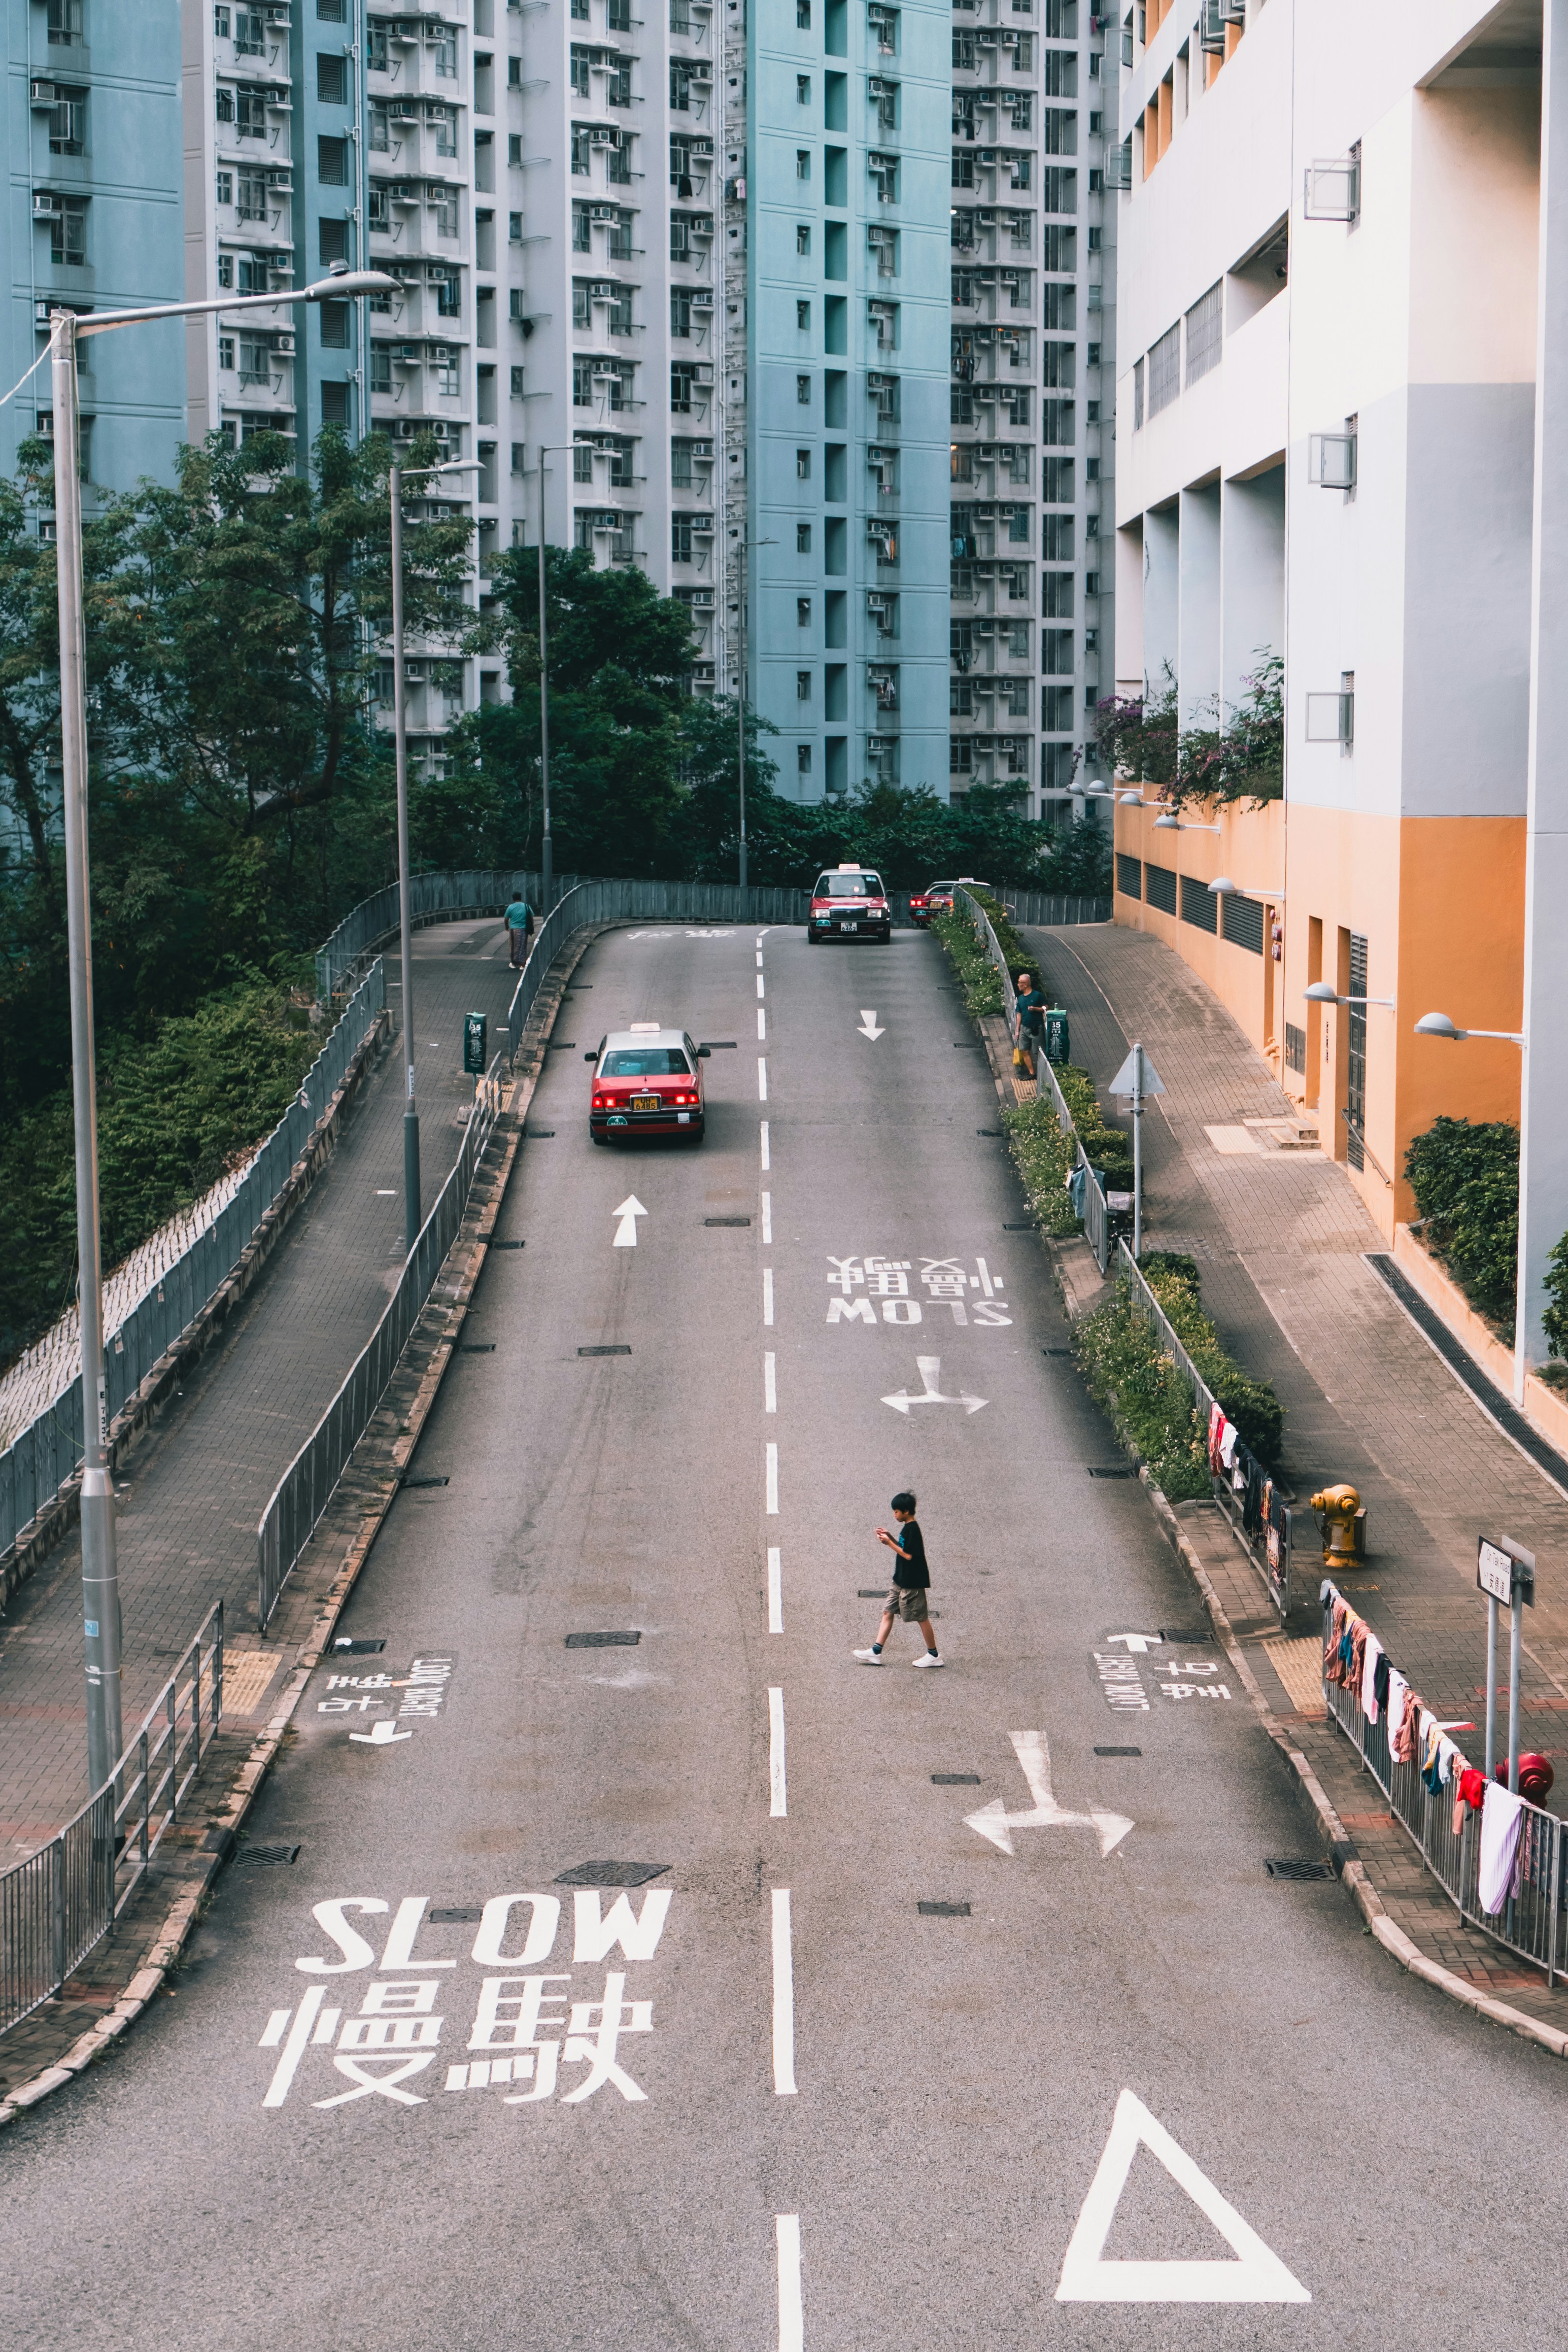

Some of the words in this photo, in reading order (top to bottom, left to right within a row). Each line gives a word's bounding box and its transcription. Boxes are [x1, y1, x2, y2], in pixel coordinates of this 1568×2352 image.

[826, 1256, 1004, 1297] 慢駛
[826, 1298, 1013, 1326] SLOW
[1486, 1549, 1492, 1562] On
[1499, 1557, 1510, 1574] Road
[409, 1658, 452, 1684] LOOK
[1094, 1653, 1140, 1680] RIGHT
[1154, 1662, 1232, 1699] 望右
[318, 1673, 393, 1713] 望右
[398, 1687, 444, 1717] RIGHT
[1105, 1683, 1150, 1711] LOOK
[295, 1889, 674, 1974] SLOW
[258, 1971, 654, 2109] 慢駛
